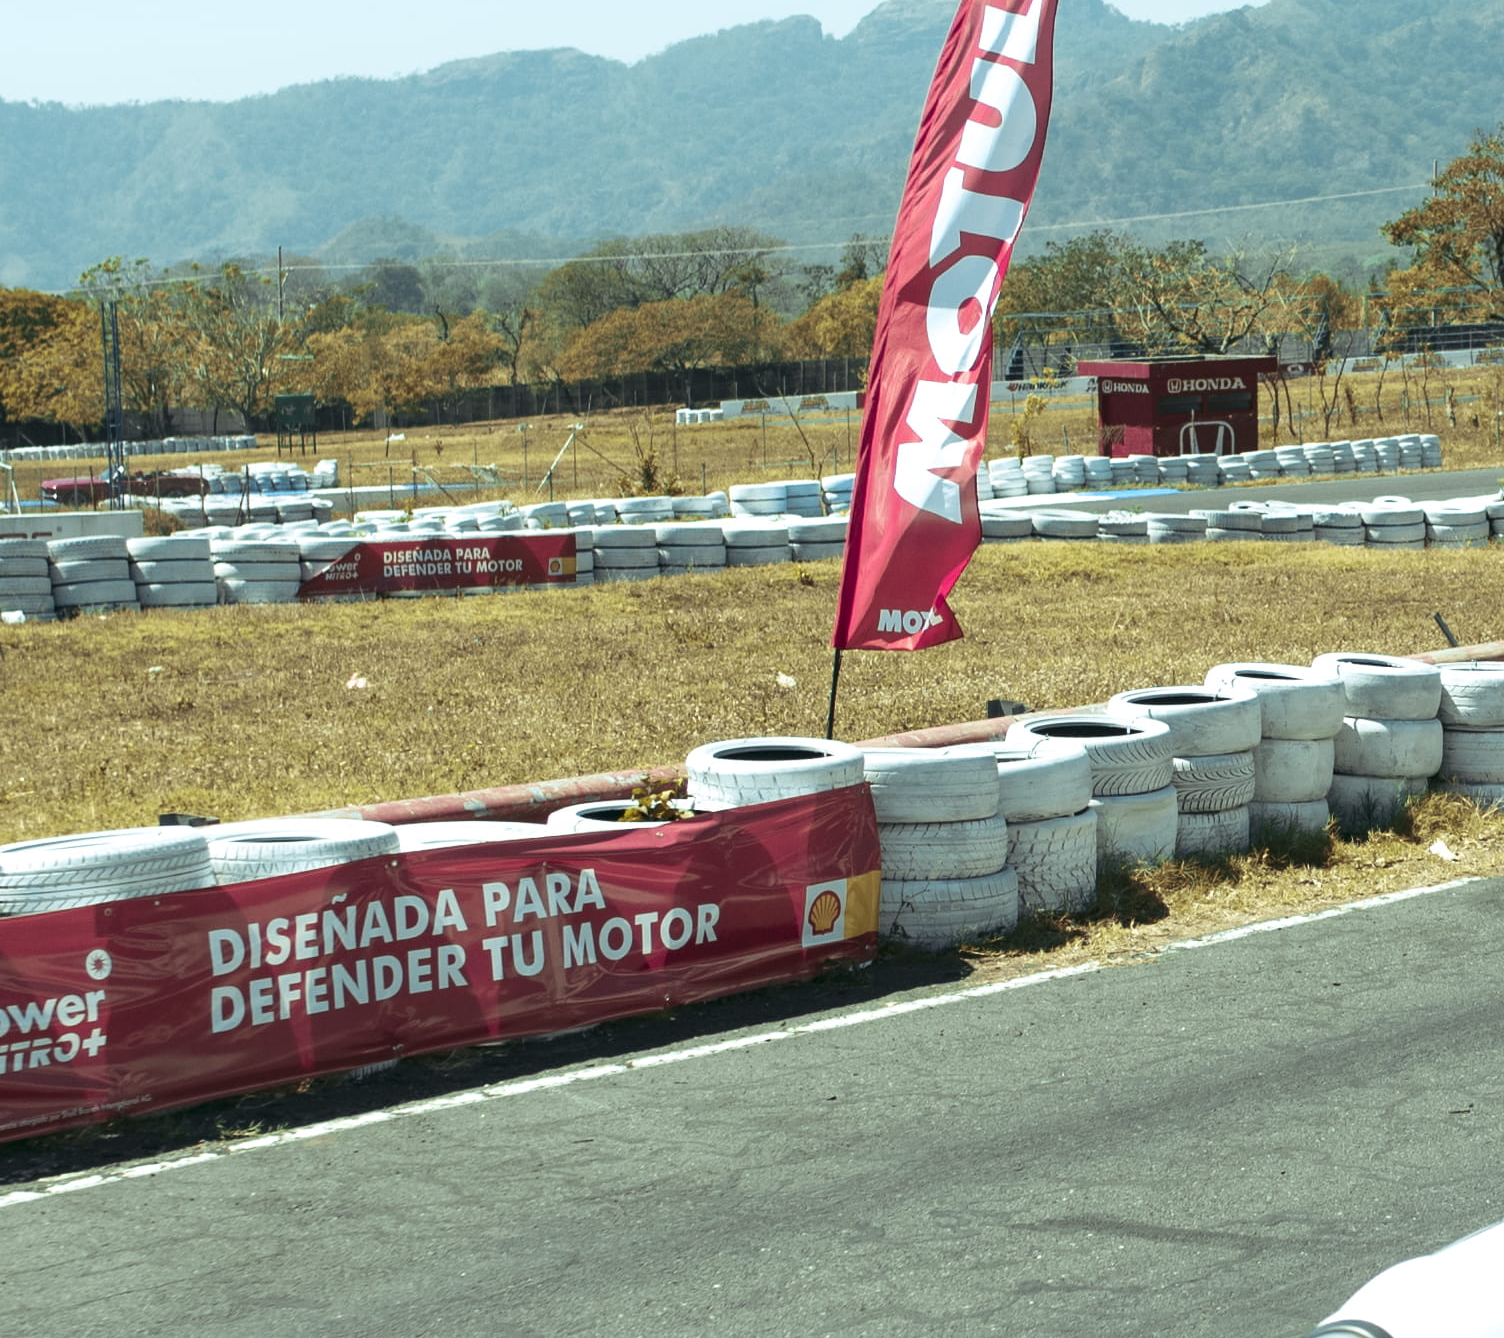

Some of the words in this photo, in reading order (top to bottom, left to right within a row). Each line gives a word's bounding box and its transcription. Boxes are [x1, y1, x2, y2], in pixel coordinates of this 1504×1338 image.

[1113, 381, 1149, 394] HONDA
[1181, 377, 1247, 391] HONDA
[383, 546, 452, 564] DISEÑADA
[455, 547, 490, 561] PARA
[383, 562, 452, 578] DEFENDER
[457, 561, 472, 574] TU
[476, 559, 523, 573] MOTOR
[209, 892, 467, 977] DISEÑADA
[482, 868, 606, 927] PARA
[211, 943, 468, 1034] DEFENDER
[482, 930, 544, 982] TU
[562, 903, 721, 970] MOTOR
